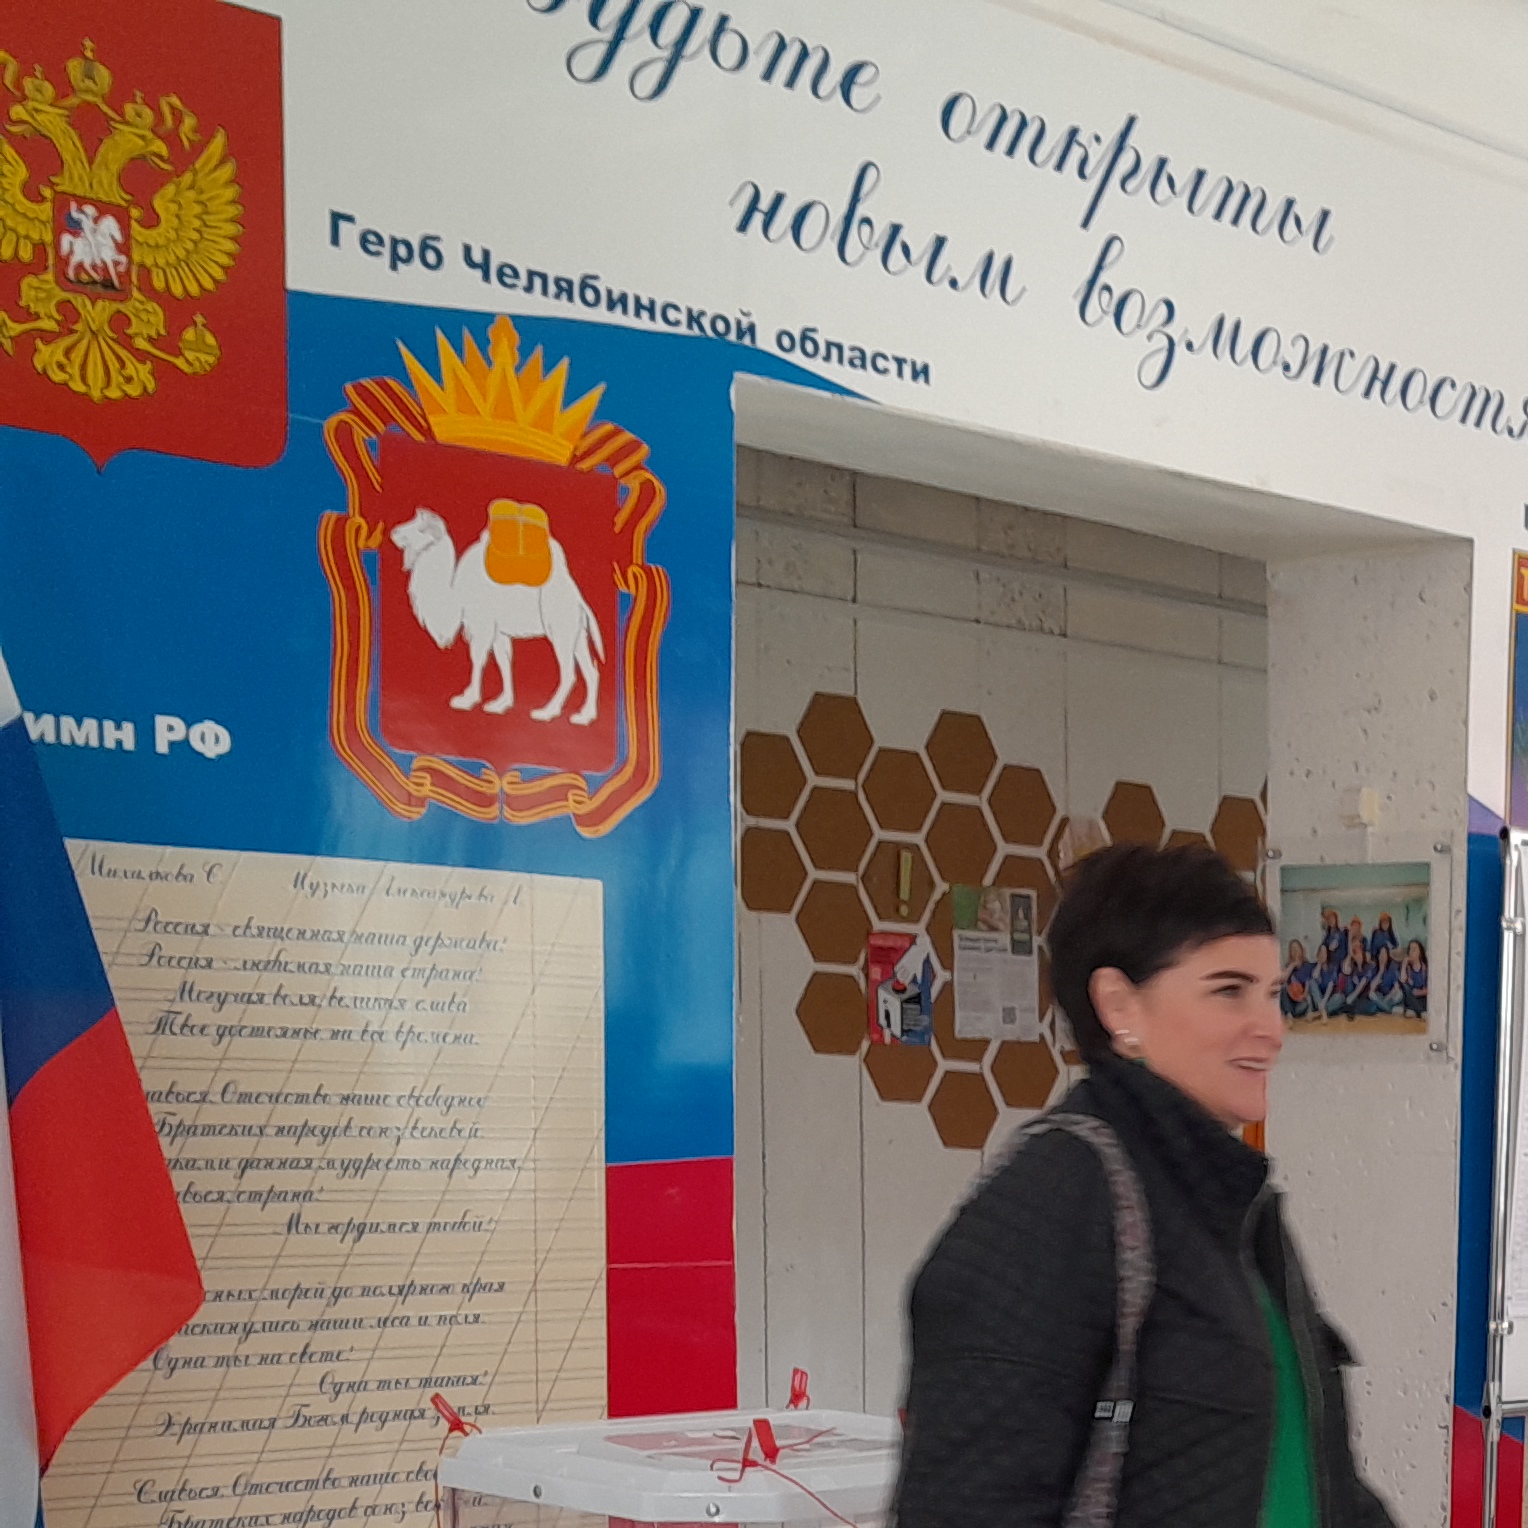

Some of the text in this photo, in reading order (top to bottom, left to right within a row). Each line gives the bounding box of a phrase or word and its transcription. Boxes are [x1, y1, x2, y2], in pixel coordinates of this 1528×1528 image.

[940, 91, 1336, 256] открыты
[730, 160, 1027, 307] новым
[327, 209, 931, 387] Герб Челябинской области
[22, 710, 233, 759] имн РФ
[134, 907, 211, 937] Россия
[232, 915, 346, 945] священная
[352, 929, 408, 947] наша
[139, 941, 214, 969] Россия
[339, 961, 395, 979] наша
[221, 1080, 331, 1106] Отечество
[340, 1092, 390, 1107] наше
[156, 1110, 268, 1147] Братских
[274, 1117, 353, 1147] народов
[232, 1156, 313, 1180] данная
[318, 1152, 422, 1181] мудрость
[286, 1211, 321, 1235] Мы
[327, 1216, 420, 1245] гордимся
[262, 1281, 326, 1310] морей
[326, 1285, 352, 1308] до
[307, 1316, 364, 1332] наши
[417, 1314, 430, 1328] и
[152, 1342, 208, 1380] Одна
[213, 1354, 251, 1369] ты
[257, 1351, 282, 1365] на
[319, 1370, 369, 1404] Одна
[376, 1377, 411, 1391] ты
[155, 1411, 278, 1446] Хранимая
[353, 1406, 427, 1433] родная
[231, 1467, 341, 1497] Отечество
[349, 1471, 401, 1487] наше
